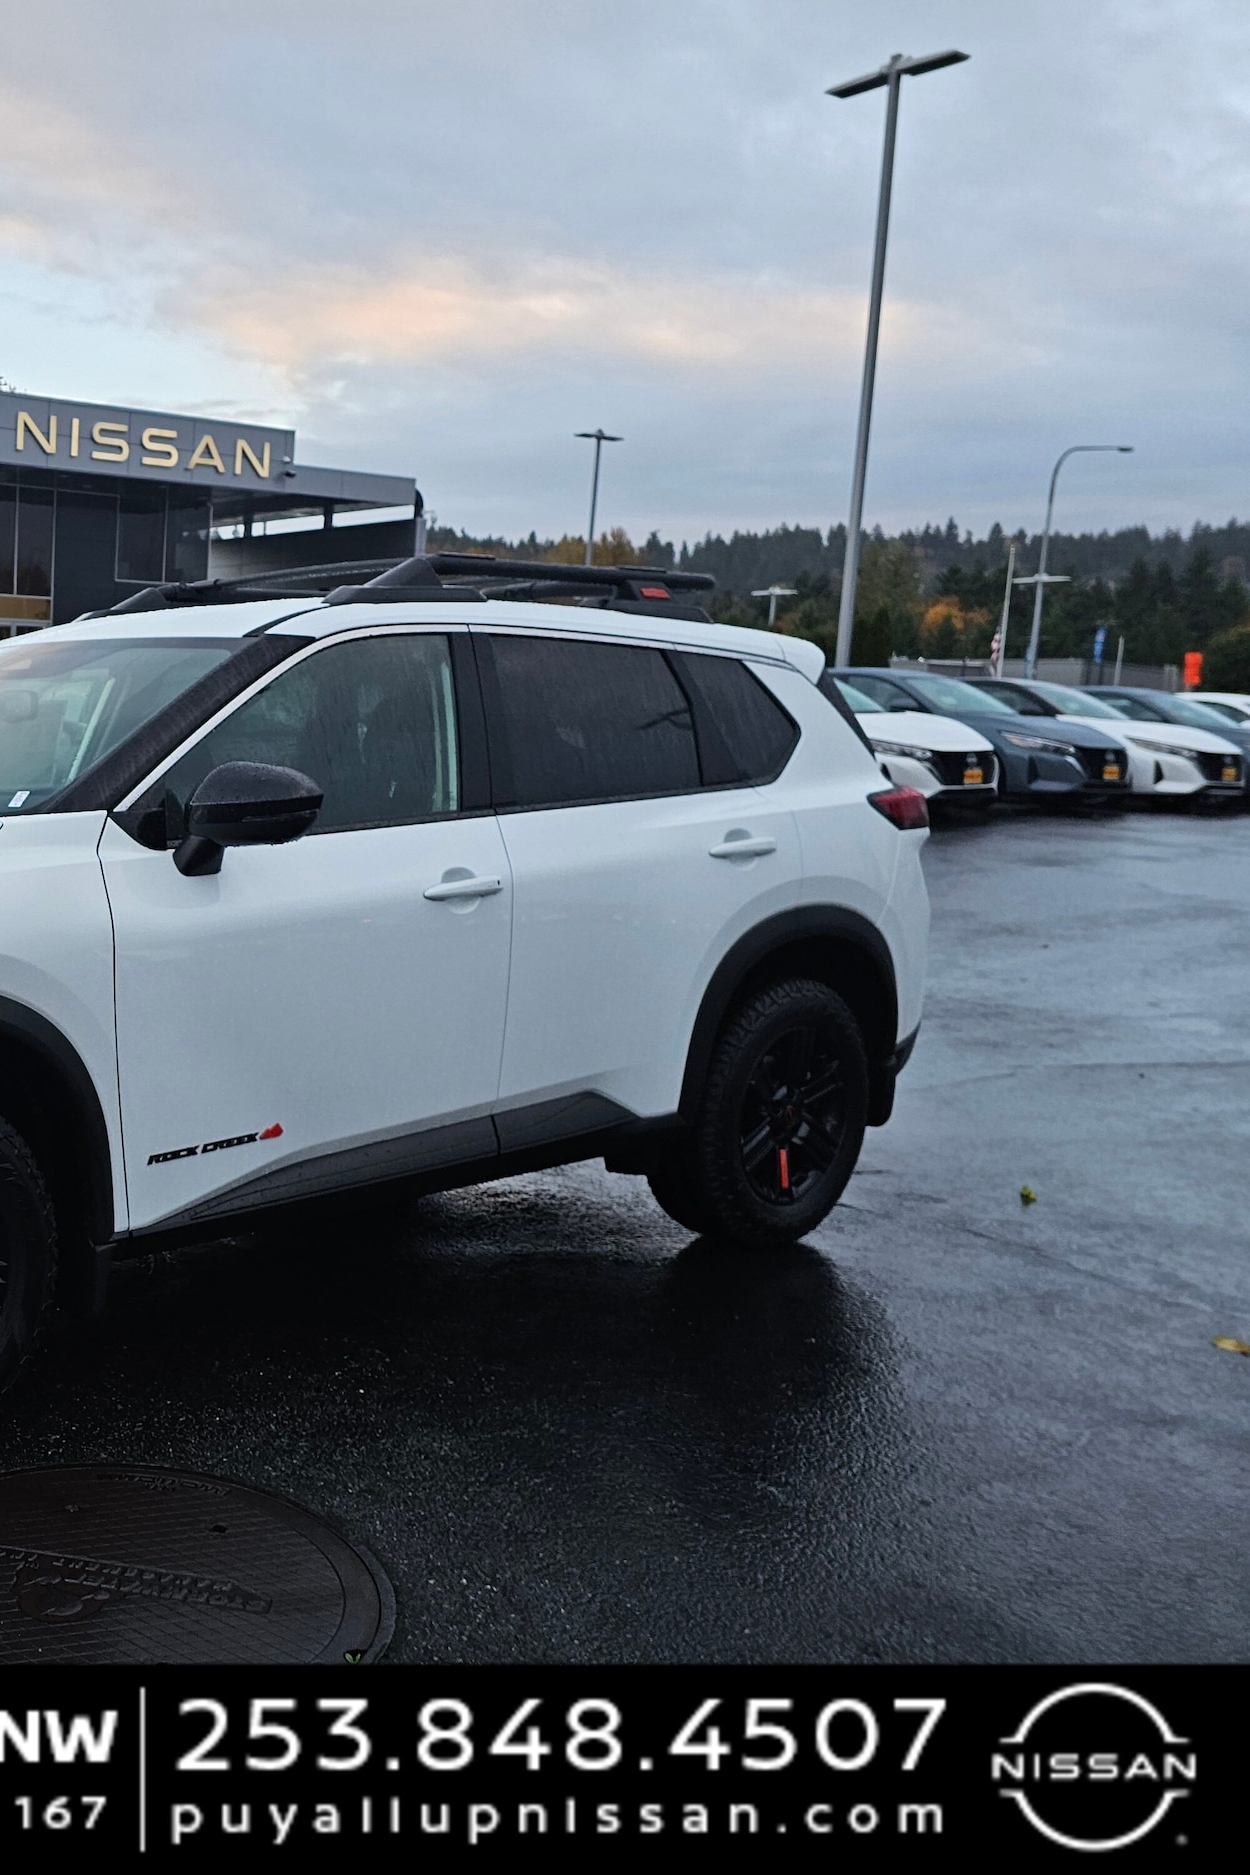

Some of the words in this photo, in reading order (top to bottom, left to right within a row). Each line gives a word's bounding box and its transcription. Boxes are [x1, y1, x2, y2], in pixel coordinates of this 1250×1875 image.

[15, 411, 271, 479] NISSAN
[147, 1145, 200, 1166] ROCK
[201, 1132, 259, 1154] CREEK
